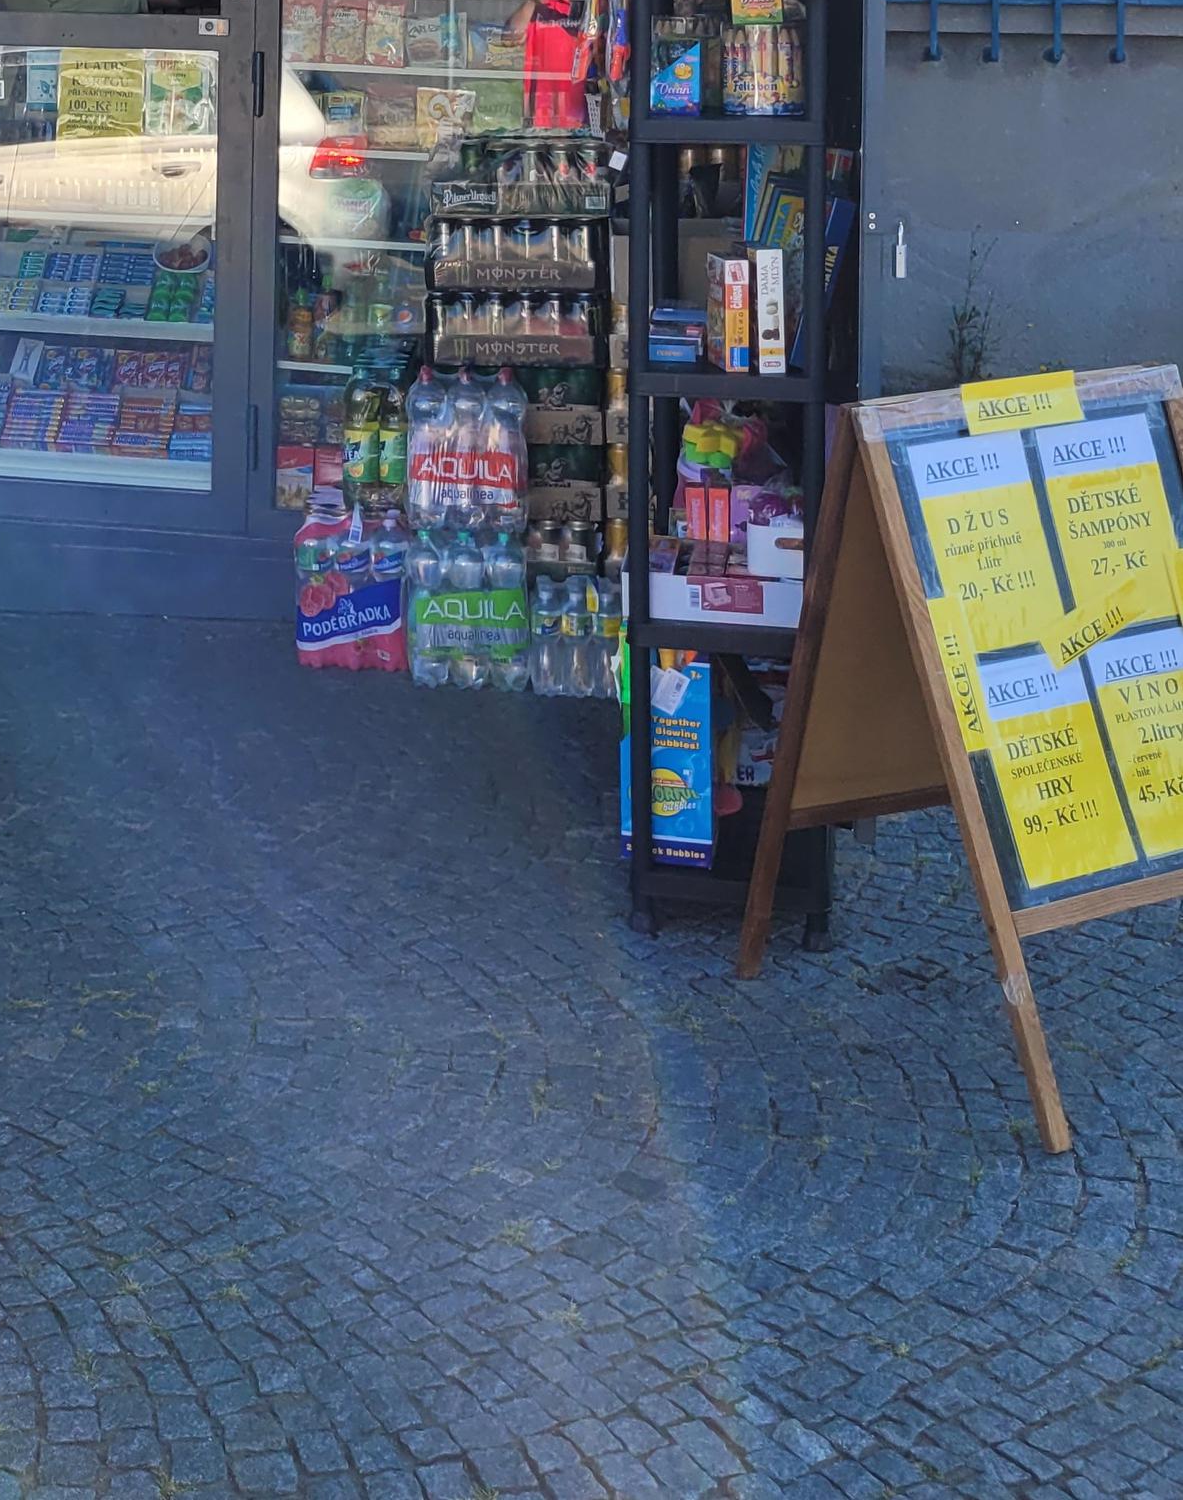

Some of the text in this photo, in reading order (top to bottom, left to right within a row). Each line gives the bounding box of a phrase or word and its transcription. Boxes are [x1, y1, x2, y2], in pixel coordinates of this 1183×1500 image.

[977, 392, 1052, 420] AKCE !!!
[1052, 436, 1126, 465] AKCE !!!
[417, 455, 513, 483] AQUILA
[925, 452, 1000, 483] AKCE !!!
[1066, 483, 1142, 515] DĚTSKÉ
[1068, 511, 1152, 541] ŠAMPÓNY
[1090, 550, 1149, 577] 27,- Kč
[959, 569, 1036, 600] 20,- Kč !!!
[302, 603, 392, 637] PODĚBRADKA
[422, 597, 526, 622] AQUILA
[447, 629, 501, 644] aqualinea
[1059, 617, 1107, 664] AKCE
[1105, 648, 1178, 682] AKCE !!!
[952, 662, 983, 734] AKCE
[987, 673, 1059, 706] AKCE !!!
[1006, 723, 1078, 761] DĚTSKÉ
[1010, 751, 1084, 781] SPOLEČENSKÉ
[1036, 774, 1074, 801] HRY
[1023, 798, 1099, 836] 99,- Kč !!!
